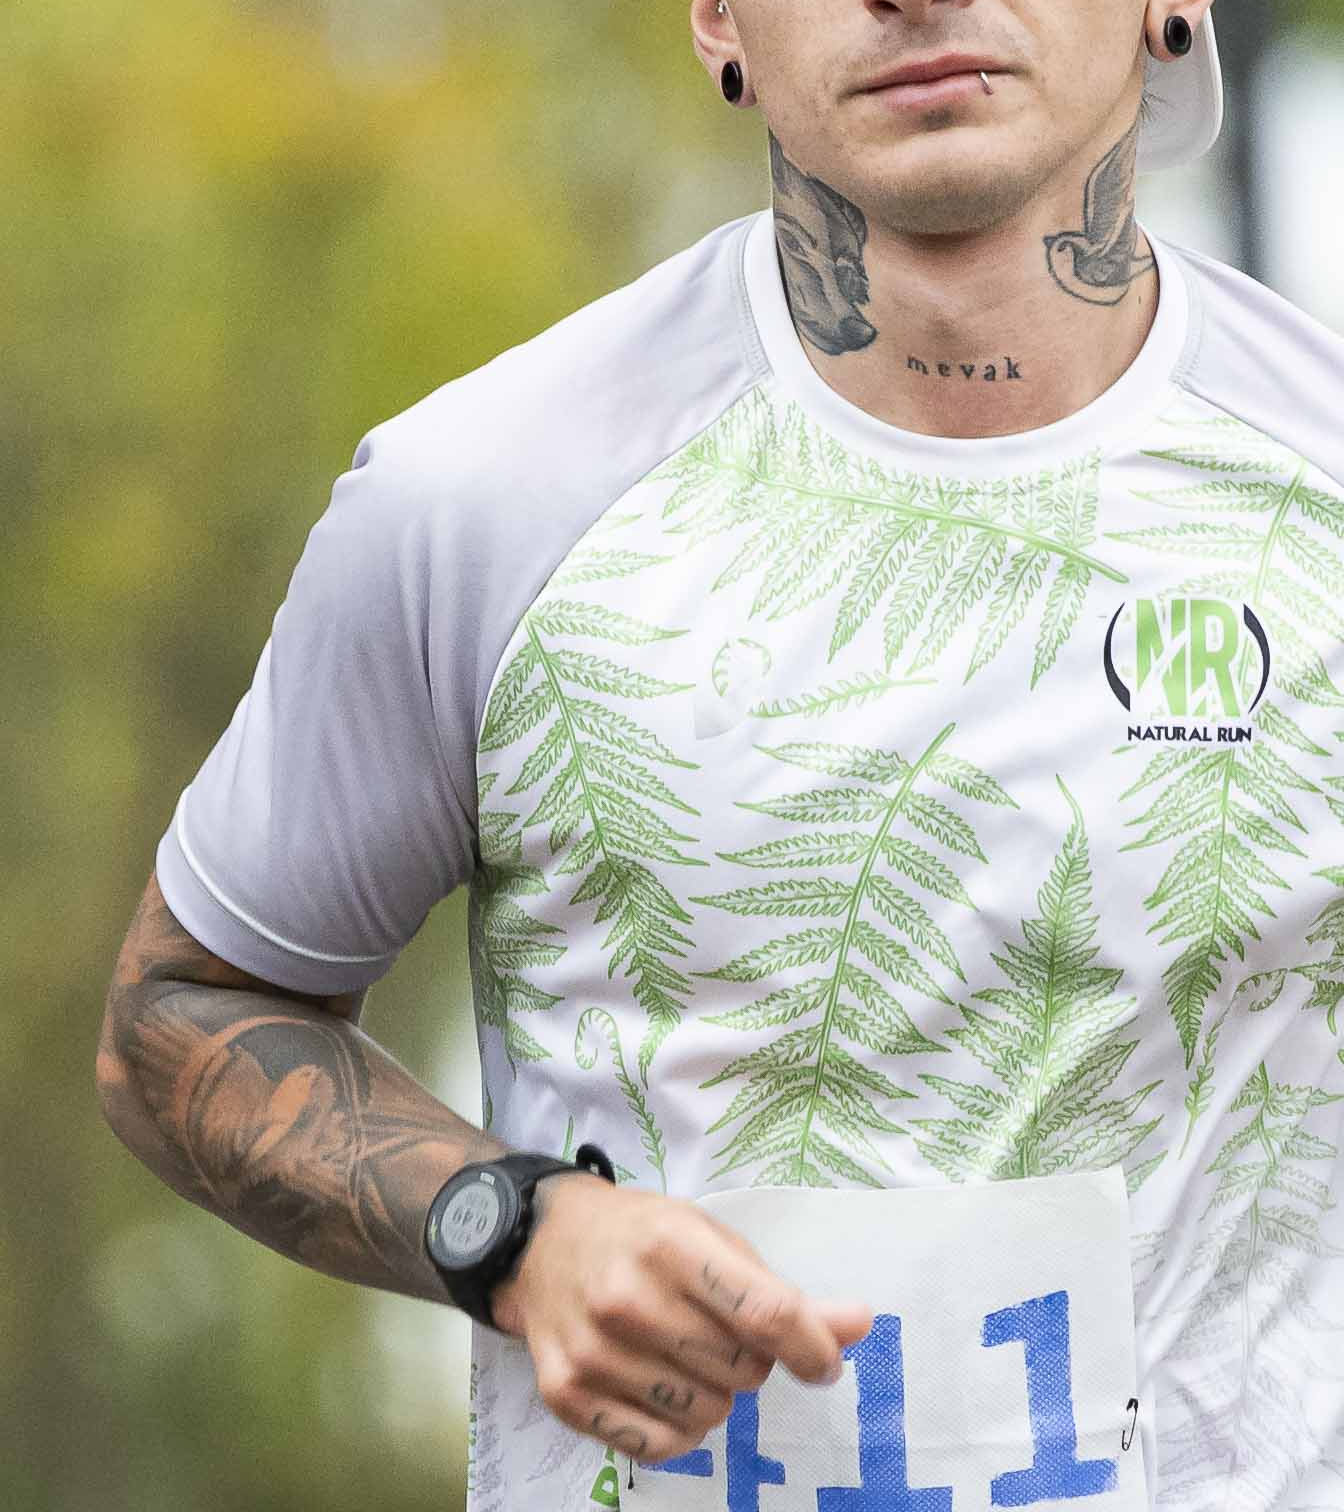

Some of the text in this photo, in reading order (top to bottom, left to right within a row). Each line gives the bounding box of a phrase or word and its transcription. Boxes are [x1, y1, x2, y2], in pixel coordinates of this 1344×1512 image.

[905, 355, 1023, 382] mevak
[1126, 725, 1253, 743] NATURAL RUN
